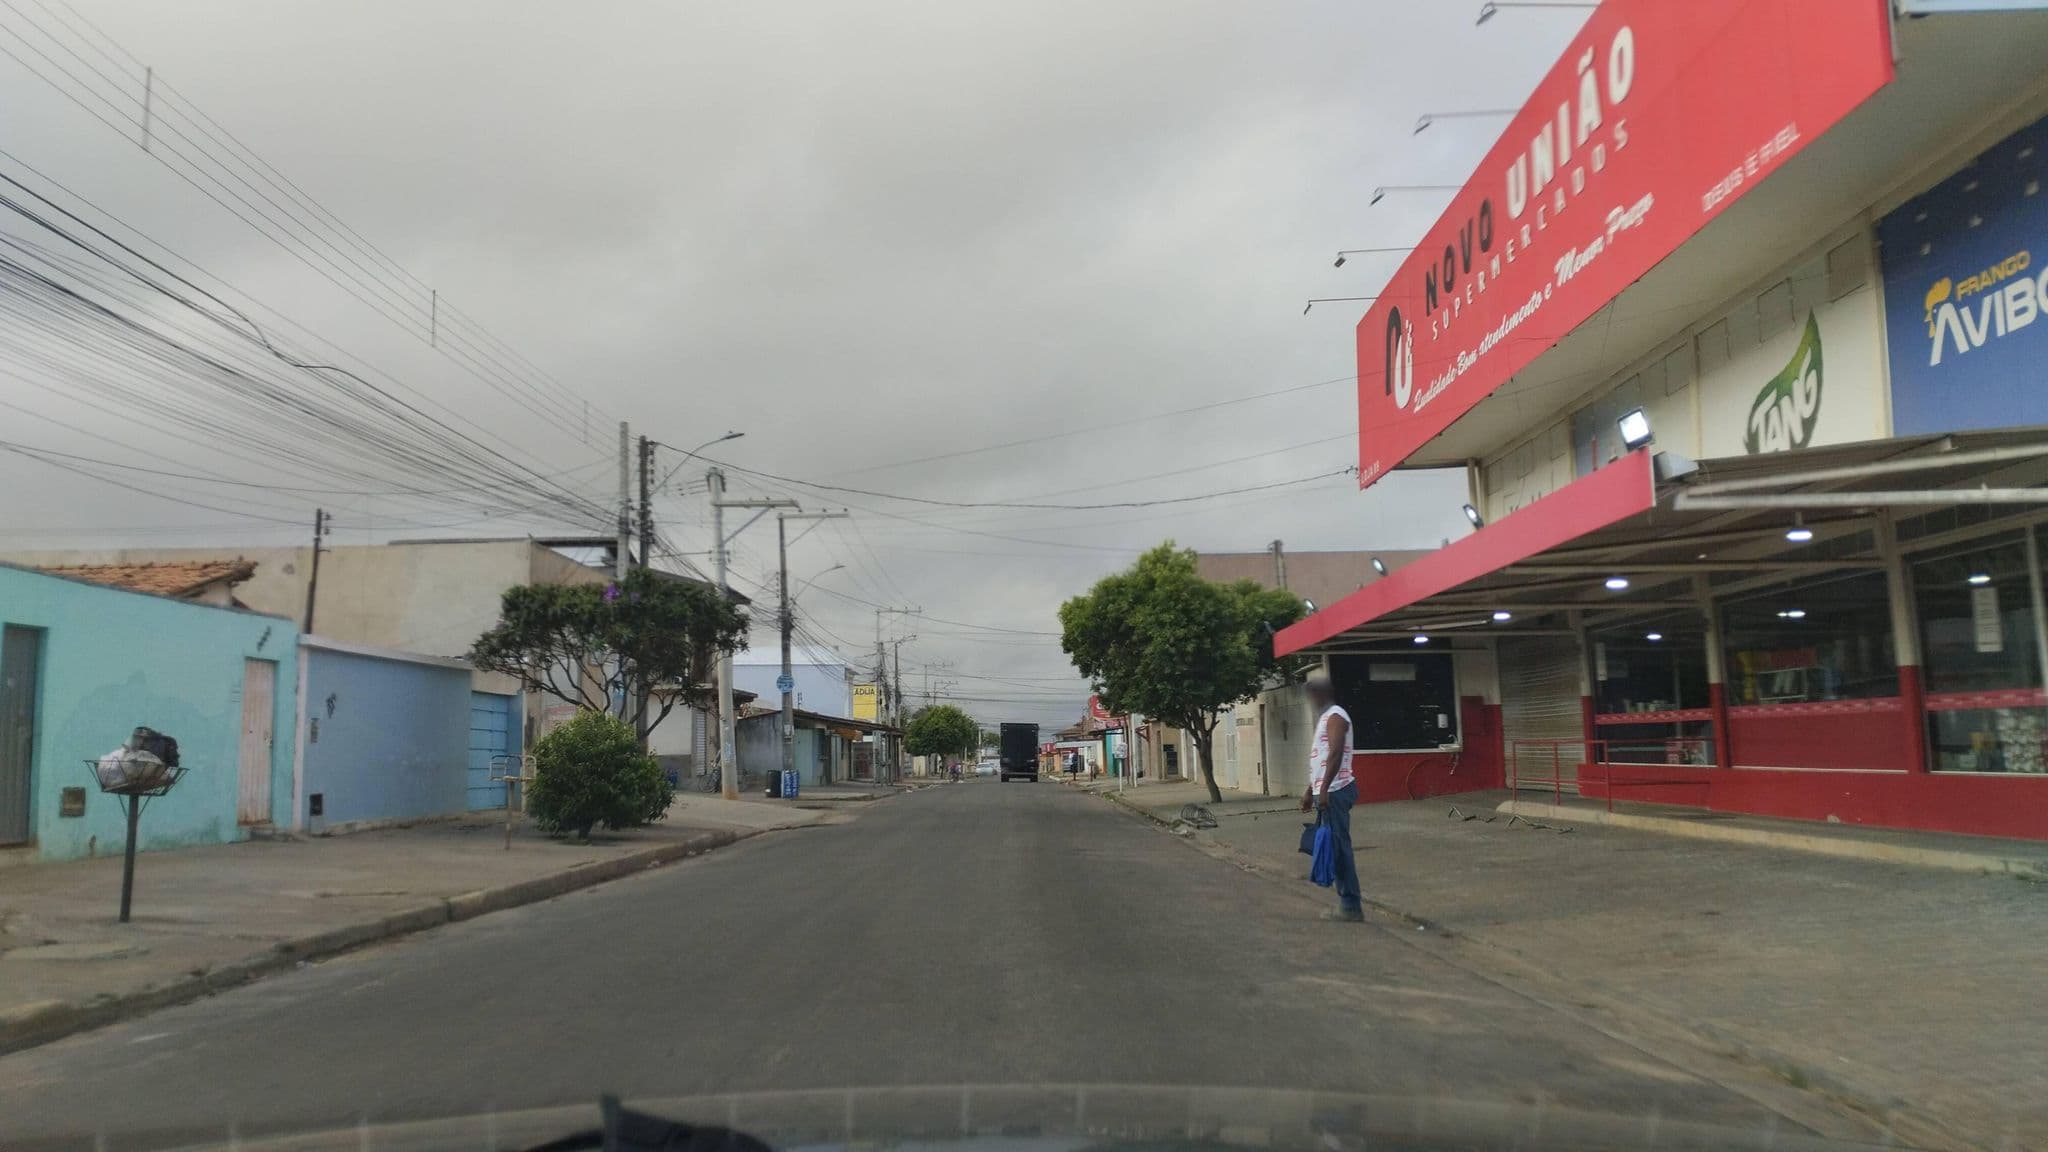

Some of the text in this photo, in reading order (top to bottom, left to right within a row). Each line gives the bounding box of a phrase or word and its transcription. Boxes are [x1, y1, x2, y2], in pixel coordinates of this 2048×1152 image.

[1426, 26, 1634, 316] NOVO UNIÃO
[1432, 118, 1628, 341] SUPERMERCADOS
[1479, 291, 1543, 355] atendimento
[1544, 282, 1552, 300] e
[1553, 247, 1604, 287] Menor
[1955, 250, 2031, 301] FRANGO
